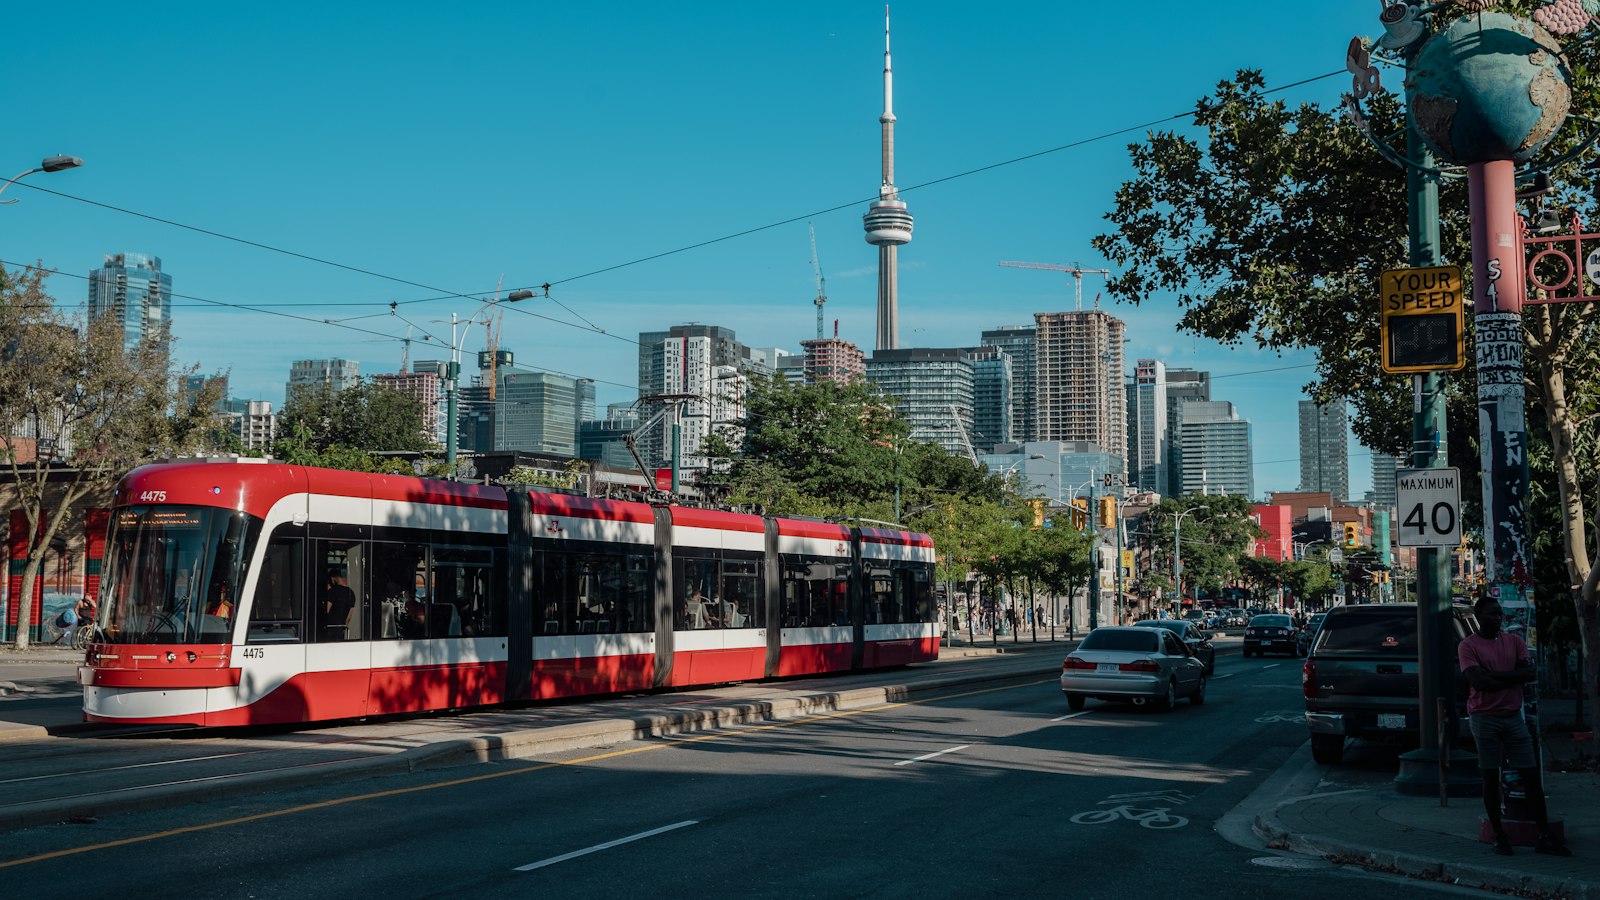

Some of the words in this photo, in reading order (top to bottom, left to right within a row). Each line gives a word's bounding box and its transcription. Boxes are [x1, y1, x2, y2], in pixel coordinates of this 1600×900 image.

[1392, 272, 1451, 291] YOUR
[1389, 291, 1455, 310] SPEED
[1400, 477, 1454, 490] MAXIMUM
[140, 490, 167, 502] 4475
[1402, 501, 1455, 536] 40
[243, 648, 264, 659] 4475
